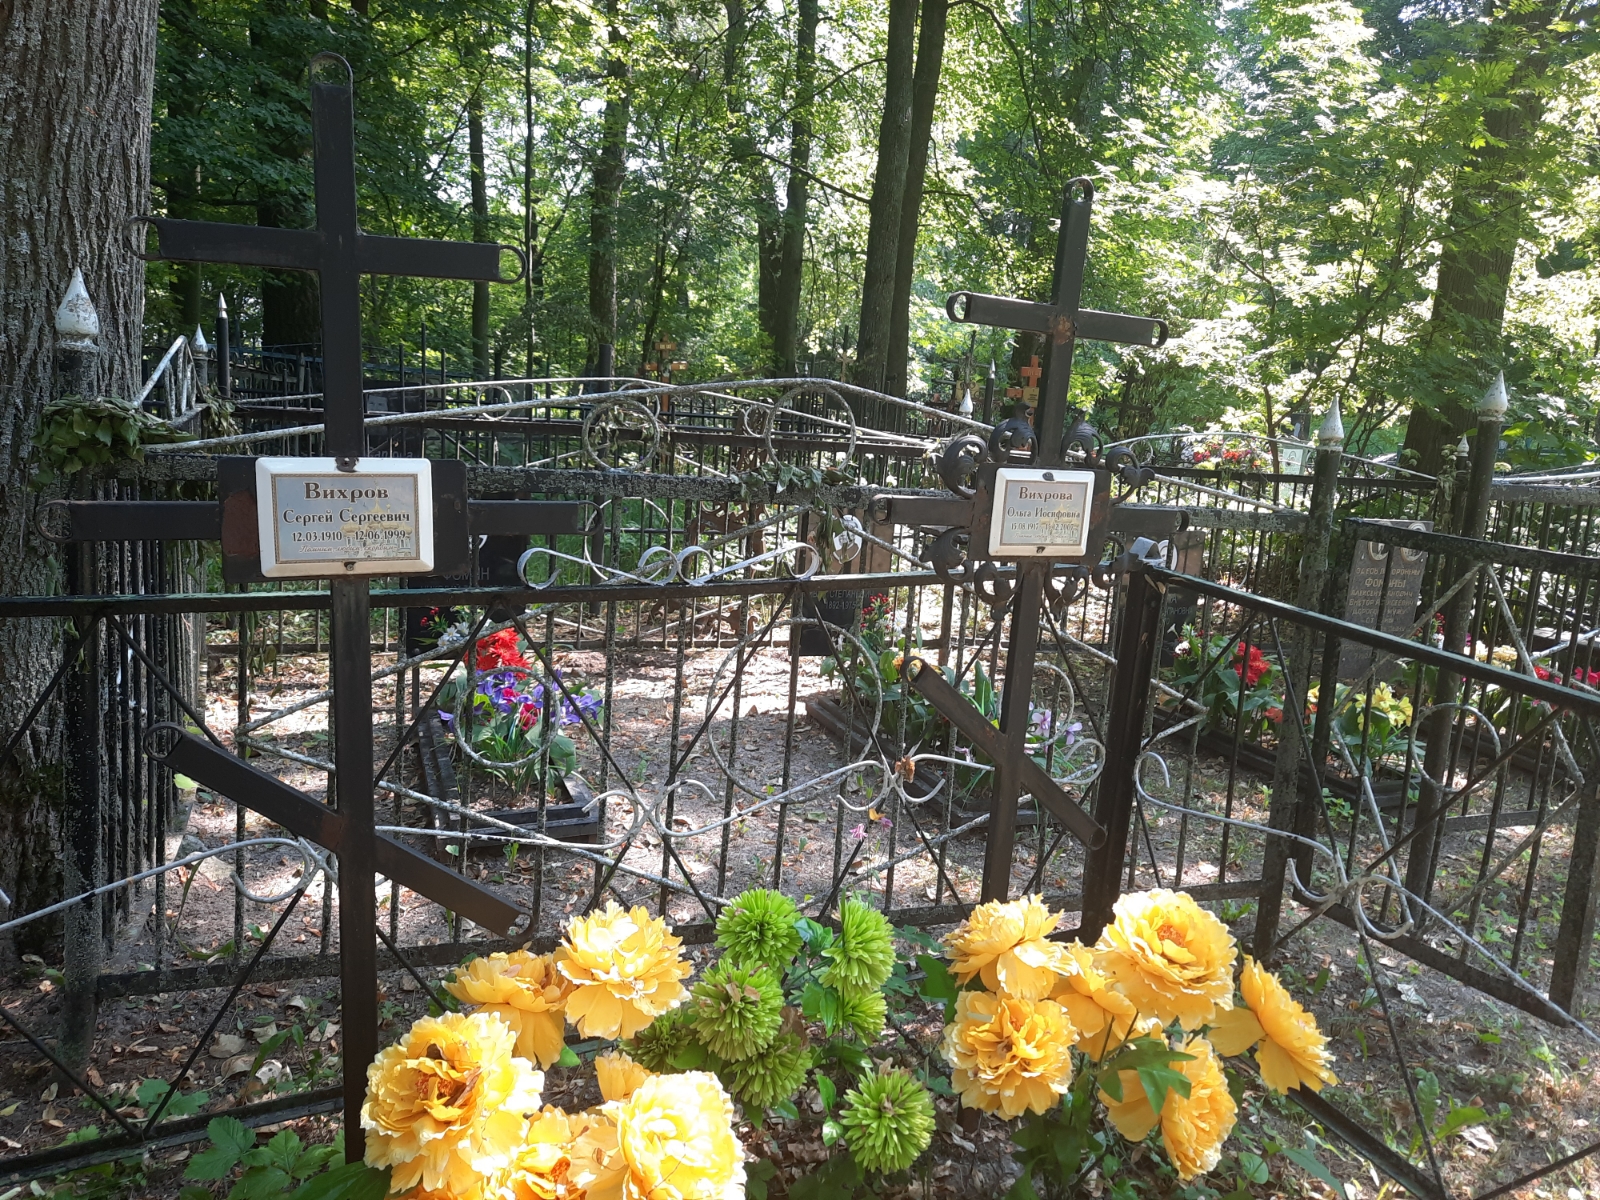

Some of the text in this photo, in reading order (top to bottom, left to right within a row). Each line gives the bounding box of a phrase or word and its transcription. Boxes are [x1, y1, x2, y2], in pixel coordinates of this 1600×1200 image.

[304, 482, 389, 503] Вихров
[1019, 486, 1073, 503] Вихрова
[283, 508, 410, 526] Сергей Сергеевич
[1007, 506, 1081, 519] Ольга Иосифовна
[292, 529, 406, 542] 12.03.1910 12.06.1999
